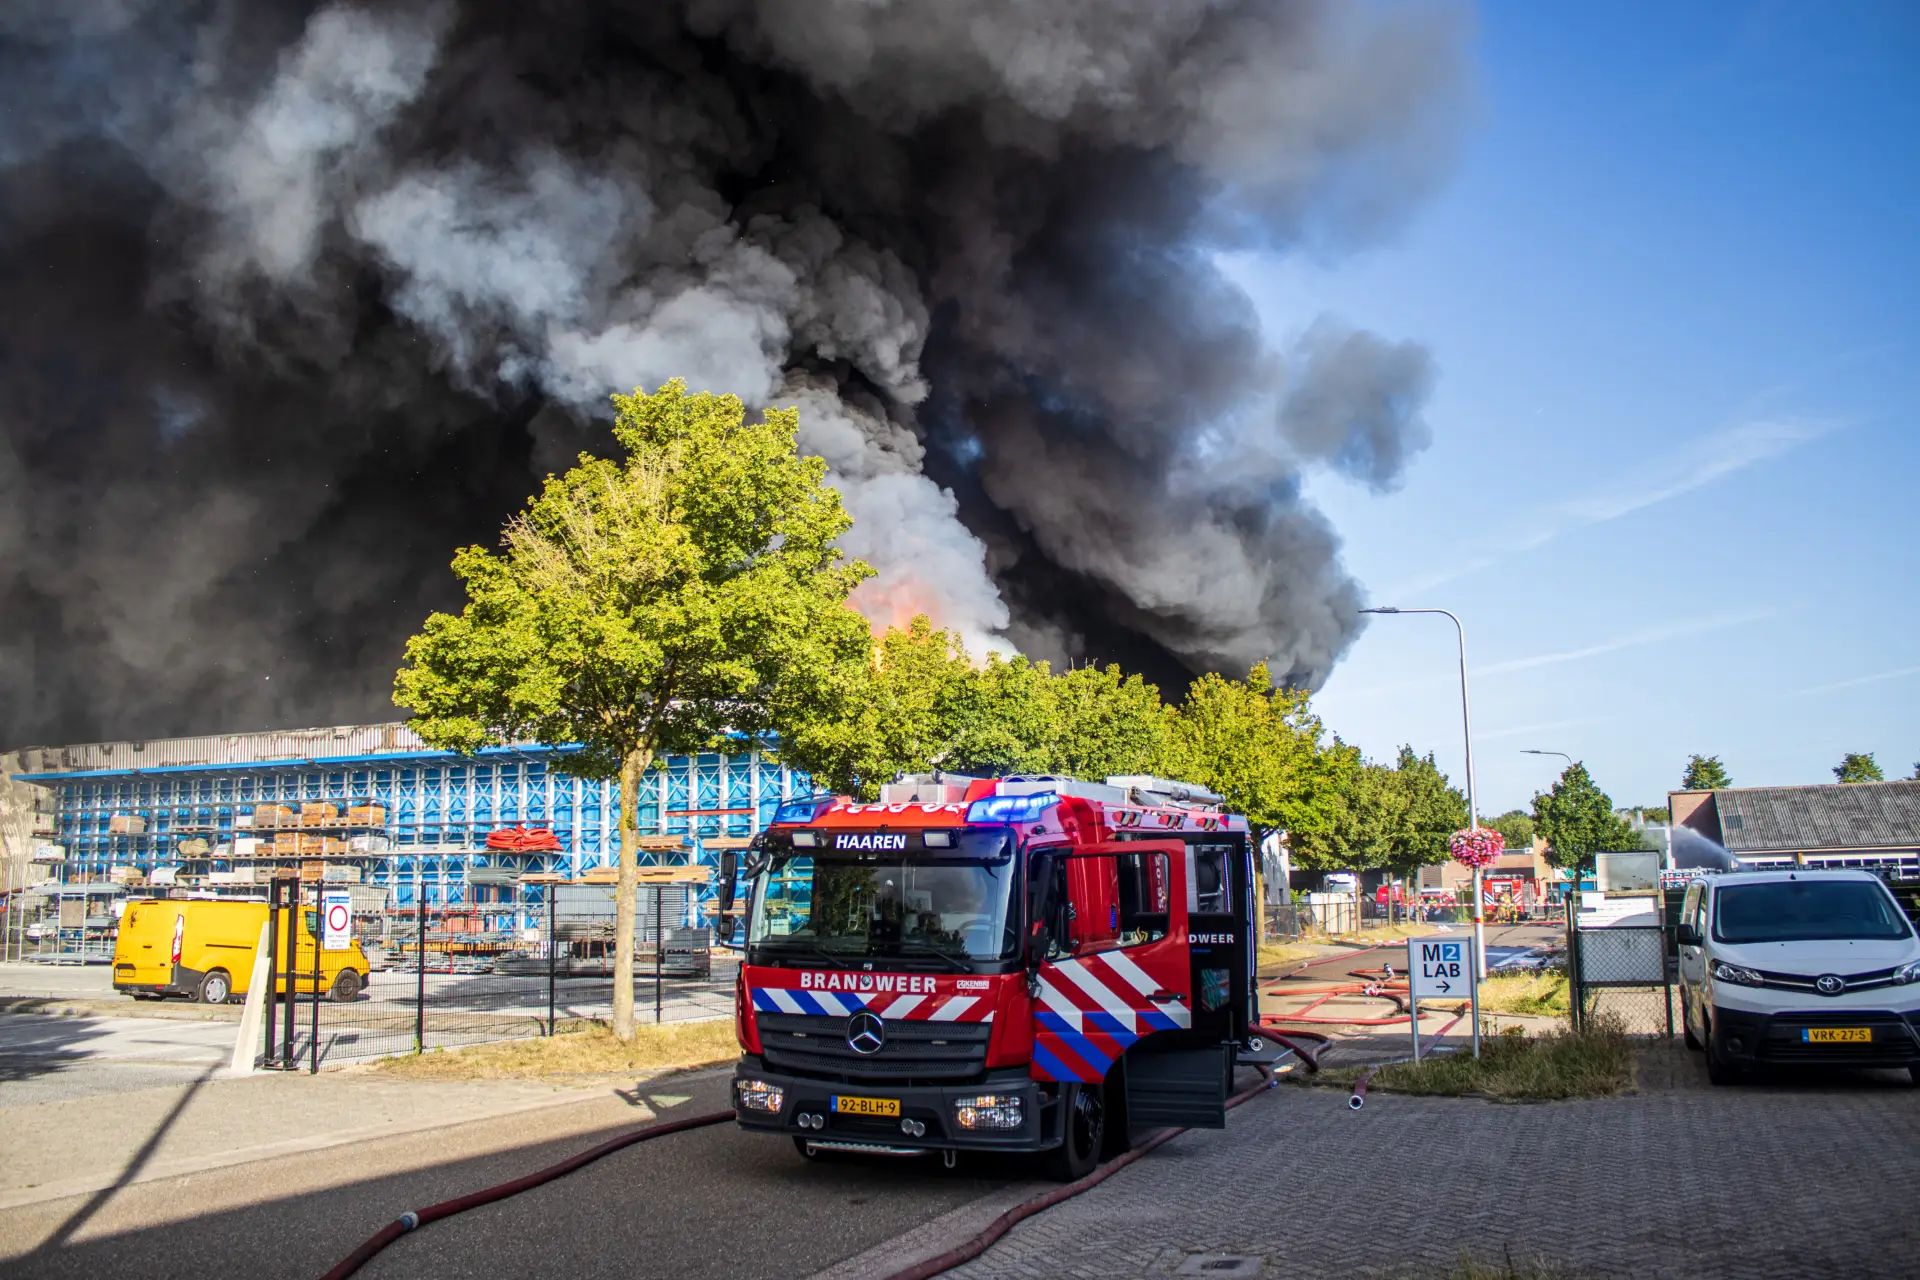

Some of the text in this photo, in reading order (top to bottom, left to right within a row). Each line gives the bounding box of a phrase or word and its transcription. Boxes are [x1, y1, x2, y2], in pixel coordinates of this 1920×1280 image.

[836, 834, 906, 849] HAAREN
[1423, 963, 1461, 978] LAB
[801, 972, 936, 993] BRANDWEER
[1812, 1030, 1866, 1040] VRK-27-S
[841, 1098, 896, 1114] 92-BLH-9
